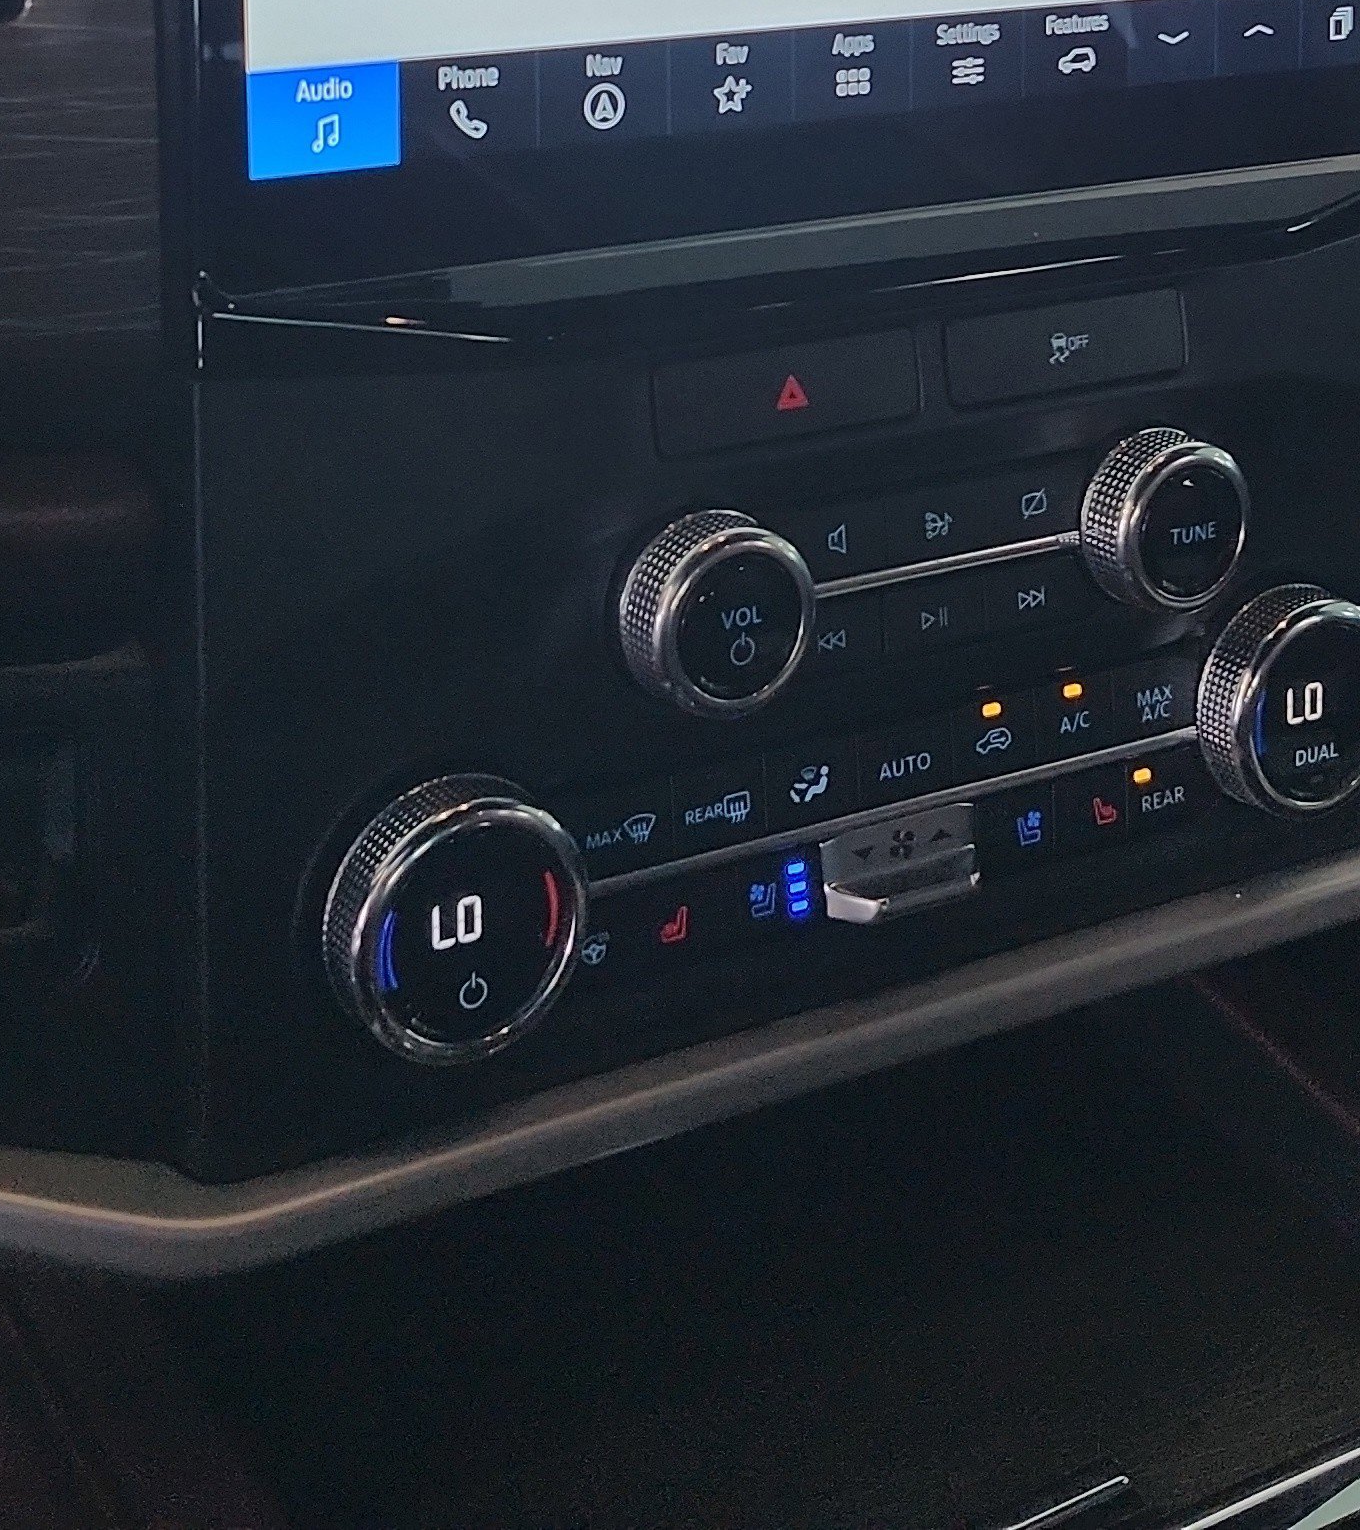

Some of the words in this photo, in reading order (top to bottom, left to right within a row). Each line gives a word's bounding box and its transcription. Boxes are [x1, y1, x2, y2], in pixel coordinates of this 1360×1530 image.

[936, 21, 1001, 46] Settings
[1045, 13, 1110, 36] Features
[715, 42, 749, 67] Fav
[831, 30, 875, 58] Apps
[438, 65, 500, 92] Phone
[585, 54, 624, 78] Nav
[295, 78, 354, 104] Audio
[1170, 521, 1218, 546] TUNE
[720, 604, 763, 631] VOL
[1137, 684, 1173, 708] MAX
[1286, 680, 1324, 726] LO
[1059, 709, 1092, 735] A/C
[1142, 700, 1171, 723] A/C
[879, 751, 932, 782] AUTO
[1295, 740, 1340, 768] DUAL
[1141, 785, 1186, 813] REAR
[685, 803, 723, 826] REAR
[585, 827, 622, 850] MAX
[430, 894, 483, 951] LO
